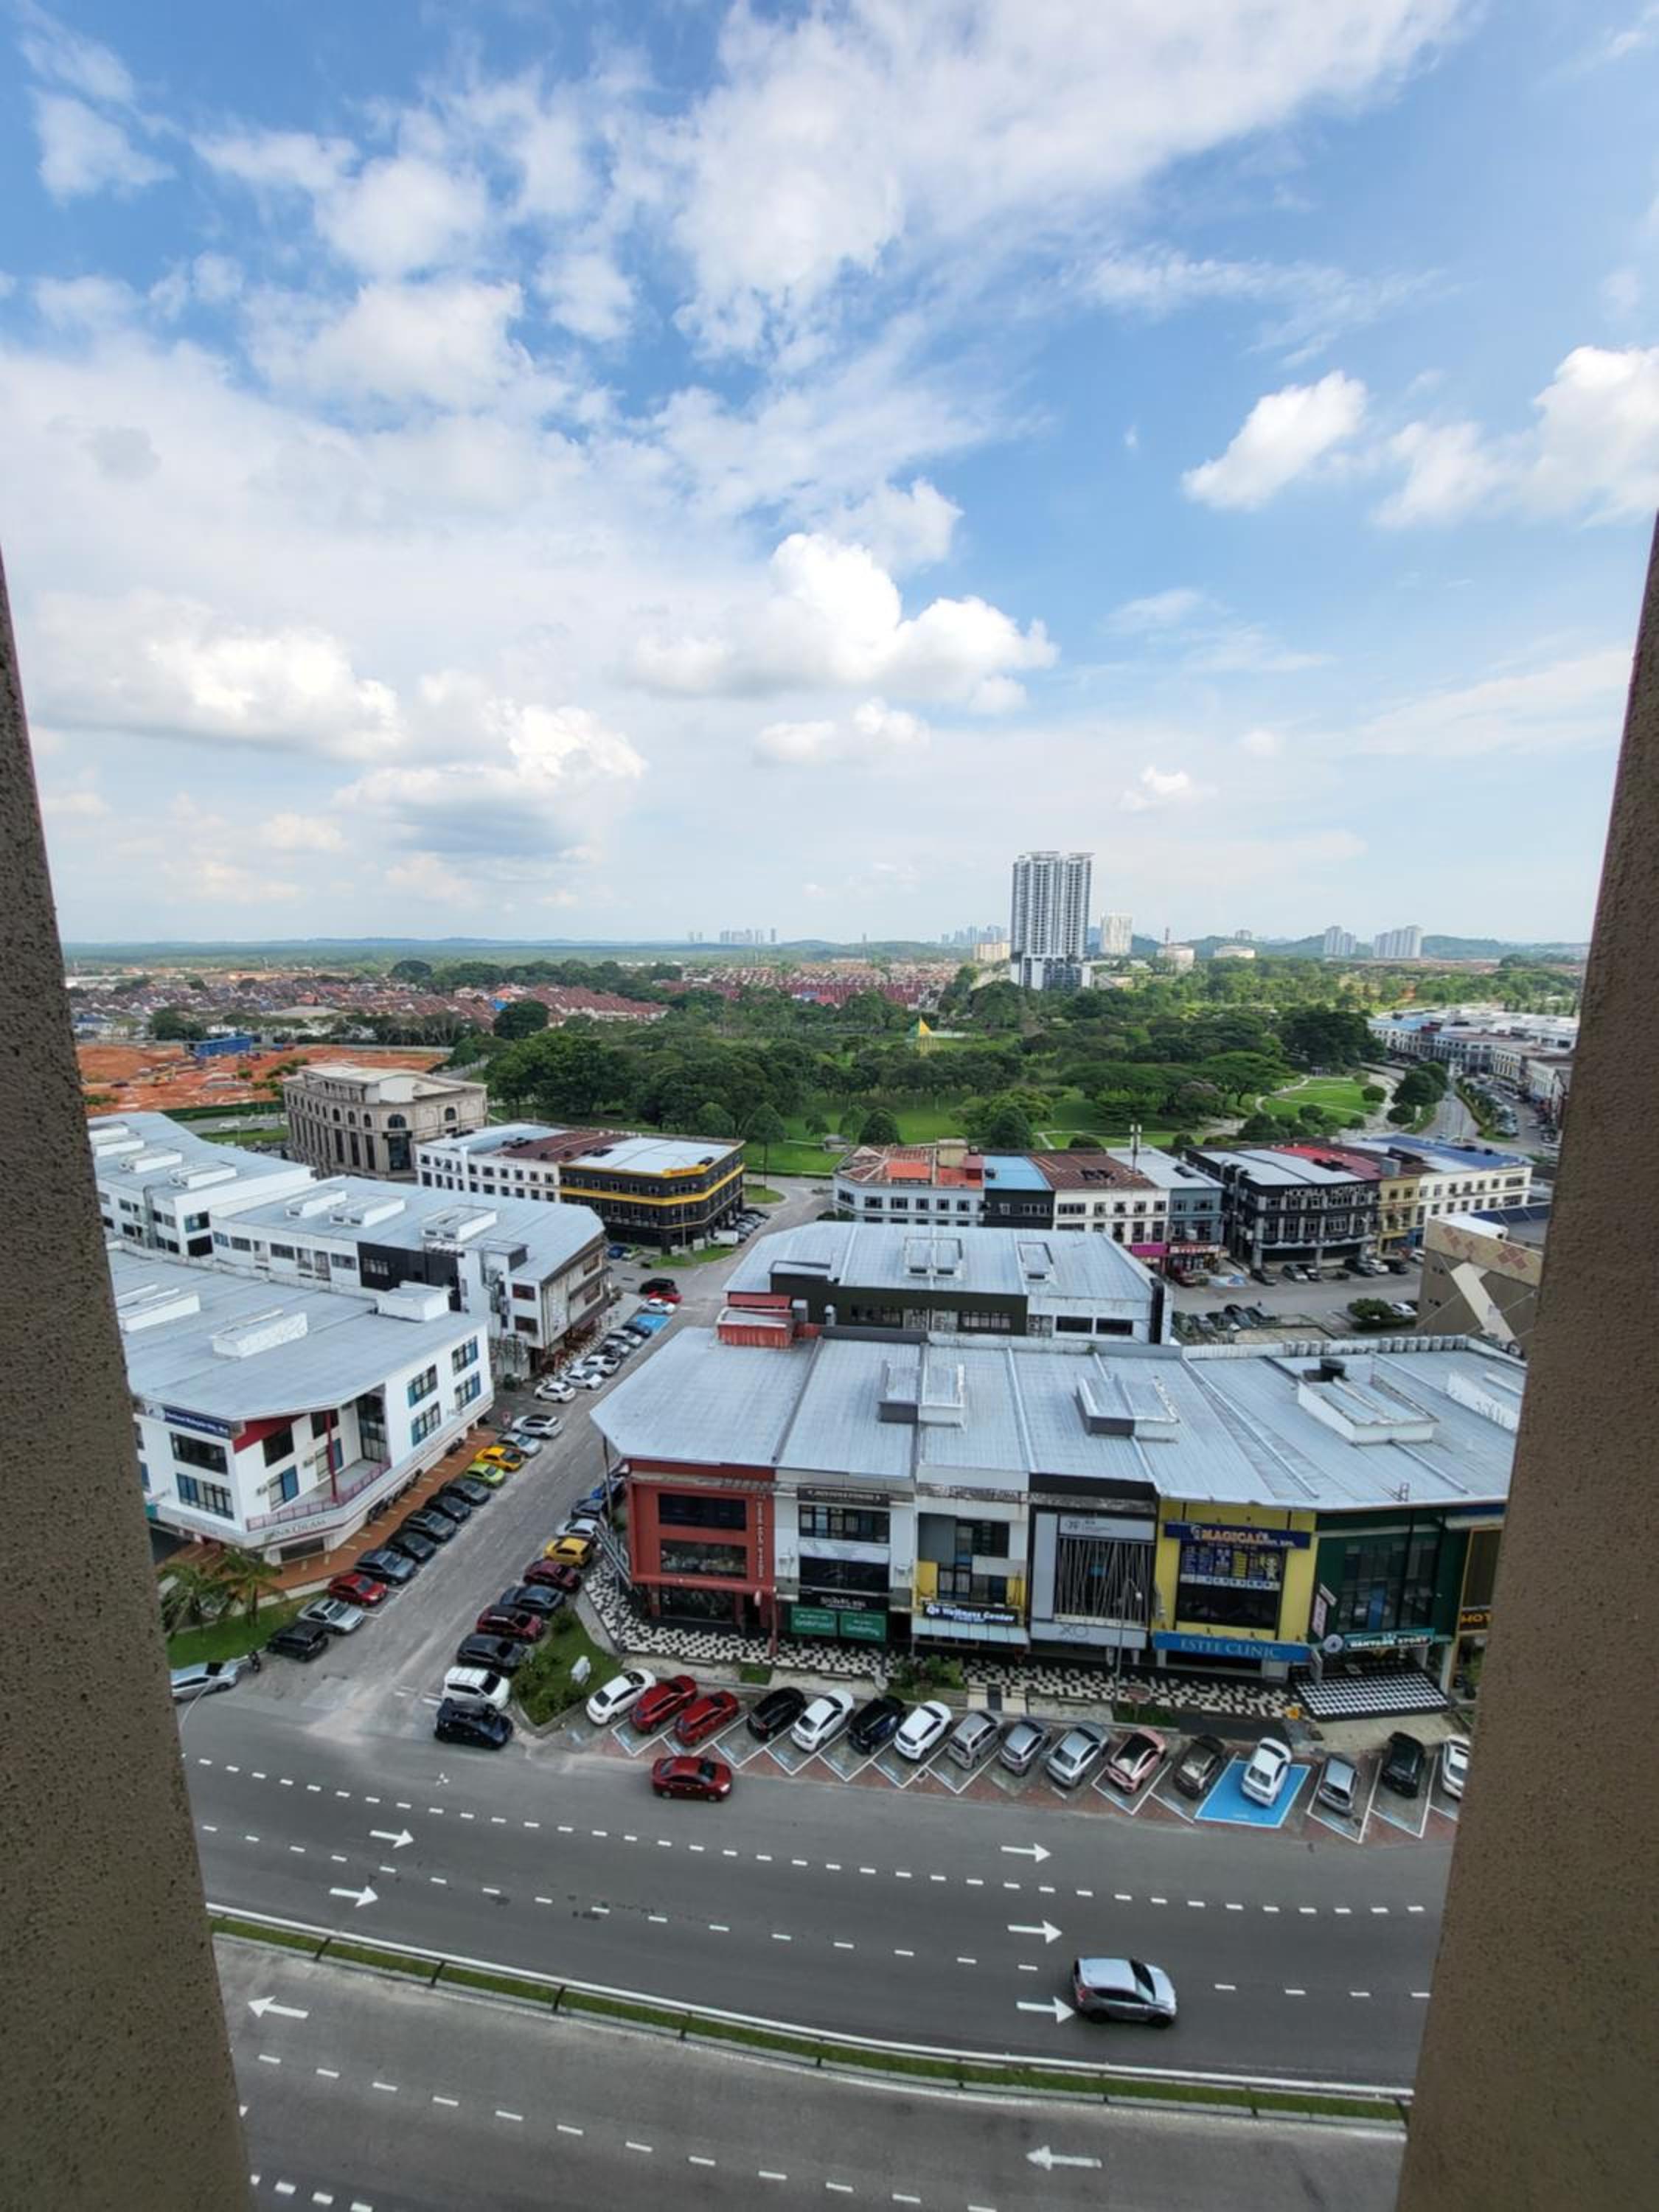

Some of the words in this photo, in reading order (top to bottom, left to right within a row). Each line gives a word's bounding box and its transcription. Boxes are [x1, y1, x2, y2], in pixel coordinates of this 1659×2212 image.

[983, 1610, 1015, 1622] Center
[1180, 1638, 1221, 1652] ESTEE
[1226, 1641, 1281, 1658] CLINIC
